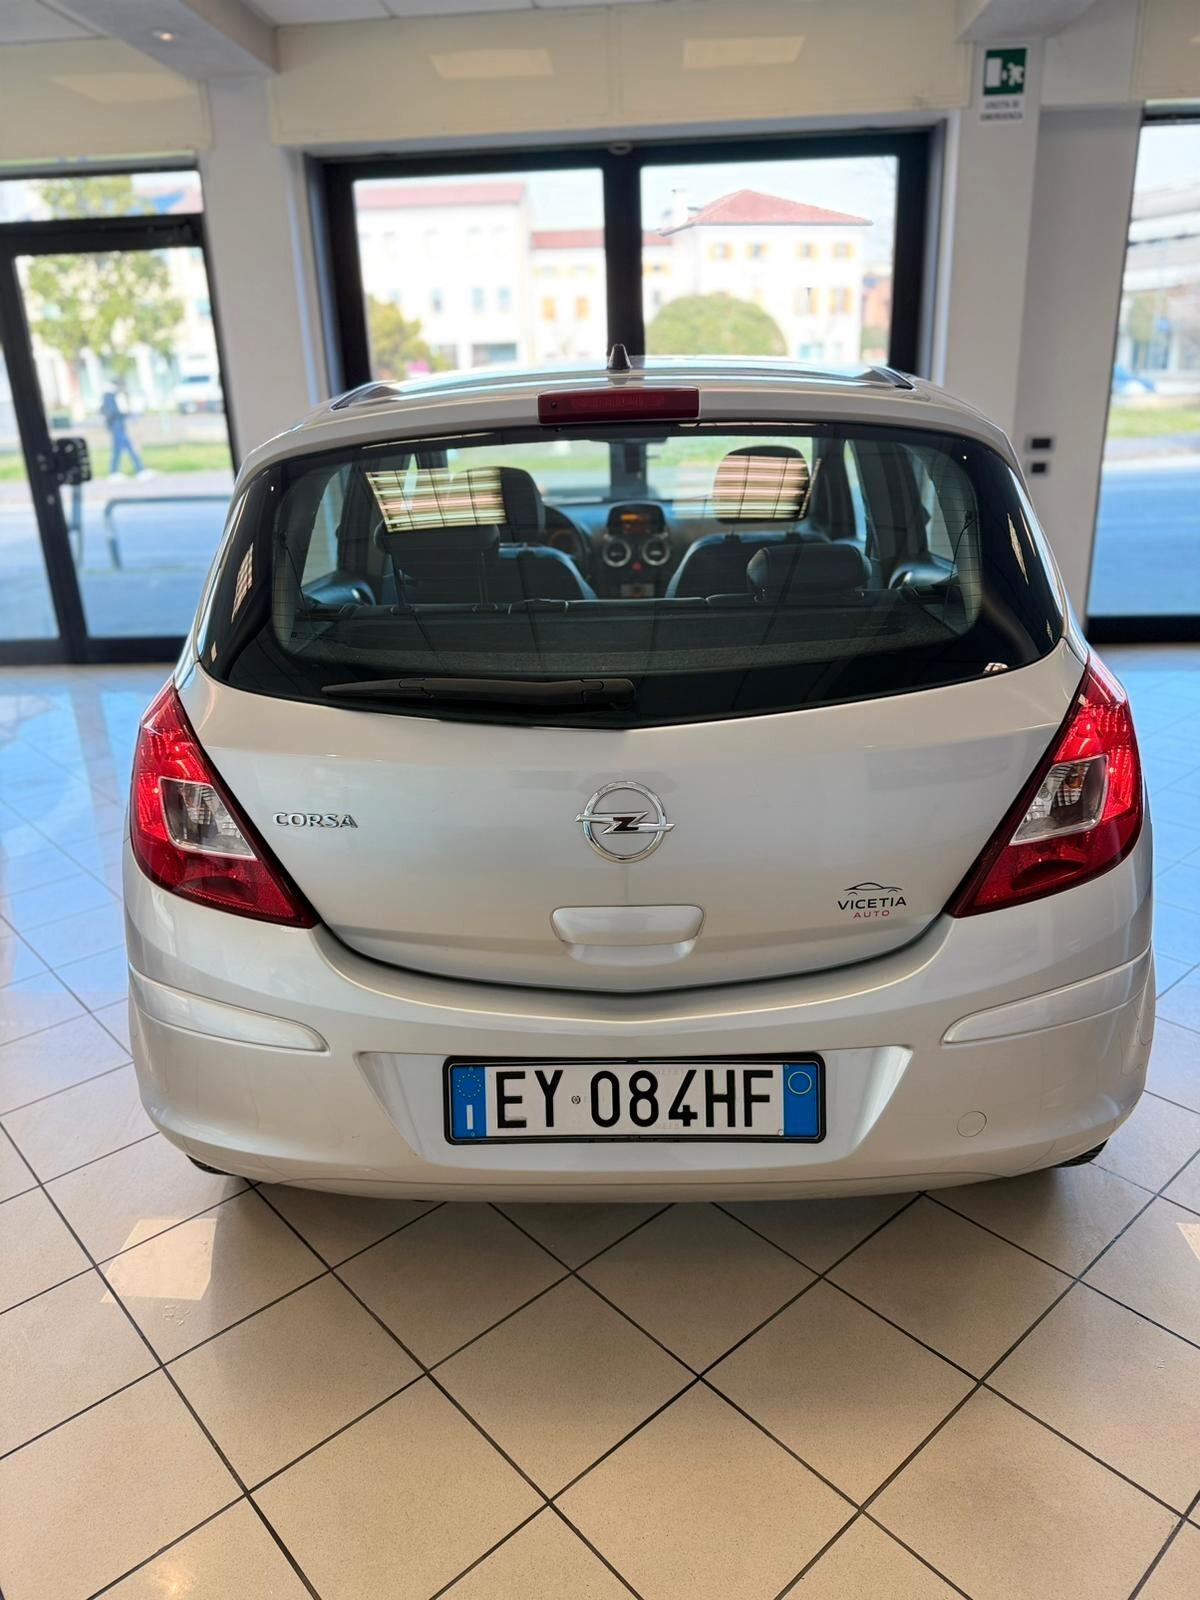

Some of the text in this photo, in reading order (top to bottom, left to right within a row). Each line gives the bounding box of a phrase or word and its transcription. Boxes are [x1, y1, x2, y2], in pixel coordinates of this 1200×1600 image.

[272, 811, 359, 828] CORSA
[837, 896, 907, 910] VICETIA
[853, 910, 890, 919] AUTO
[495, 1069, 774, 1129] EY 084HF
